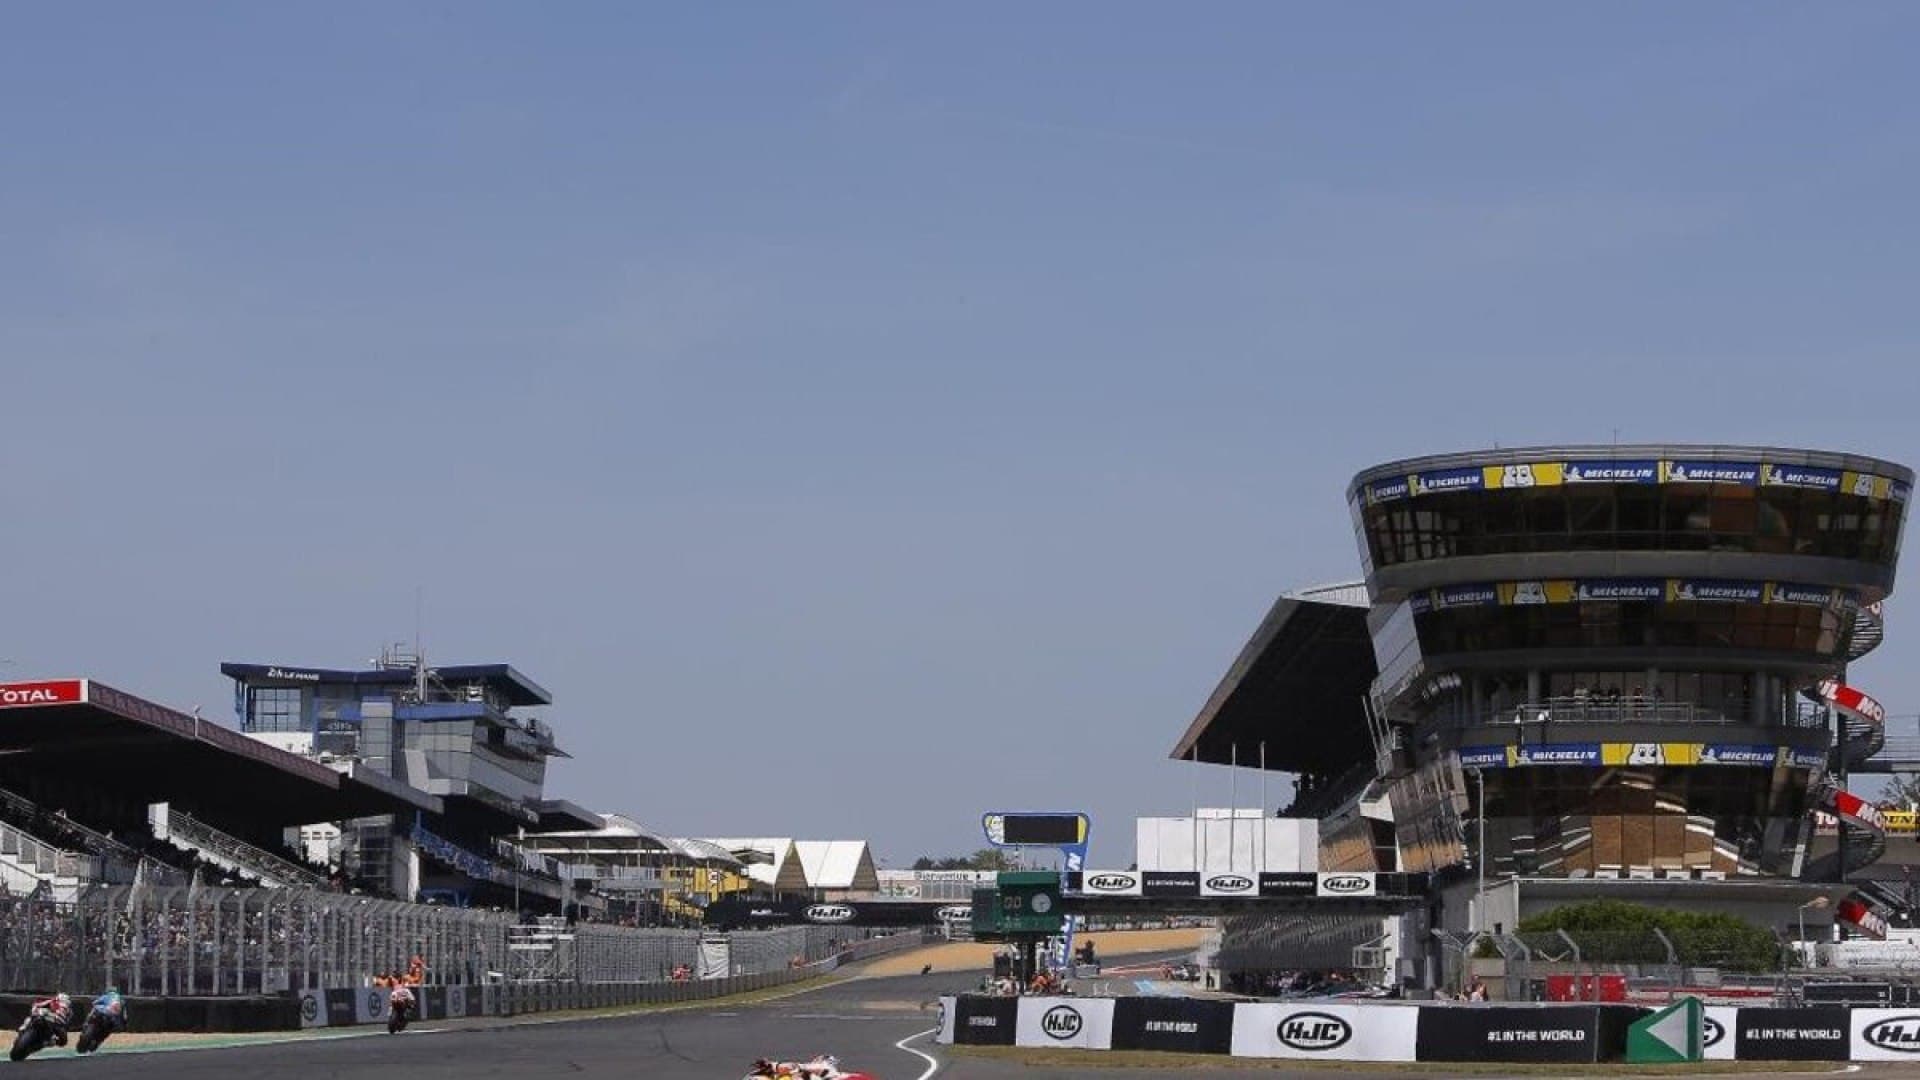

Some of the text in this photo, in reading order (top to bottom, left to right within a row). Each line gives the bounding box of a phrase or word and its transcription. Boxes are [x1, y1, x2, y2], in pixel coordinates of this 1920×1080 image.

[1584, 468, 1654, 479] MICHELIN
[1689, 469, 1756, 480] MICHELIN
[1429, 475, 1480, 489] MICHELIN
[1447, 591, 1494, 603] MICHELIN
[1592, 586, 1660, 597] MICHELIN
[1697, 588, 1760, 598] MICHELIN
[1461, 752, 1505, 764] MICHELIN
[1532, 751, 1598, 761] MICHELIN
[1719, 752, 1775, 762] MICHELIN
[1094, 877, 1130, 888] HJC
[1212, 879, 1247, 888] HJC
[1329, 879, 1364, 888] HJC
[1047, 1014, 1078, 1031] HJC
[1285, 1021, 1341, 1041] HJC
[1487, 1030, 1585, 1041] #1 IN THE WORLD
[1746, 1028, 1842, 1040] #1 IN THE WORLD
[1878, 1025, 1920, 1043] HJ
